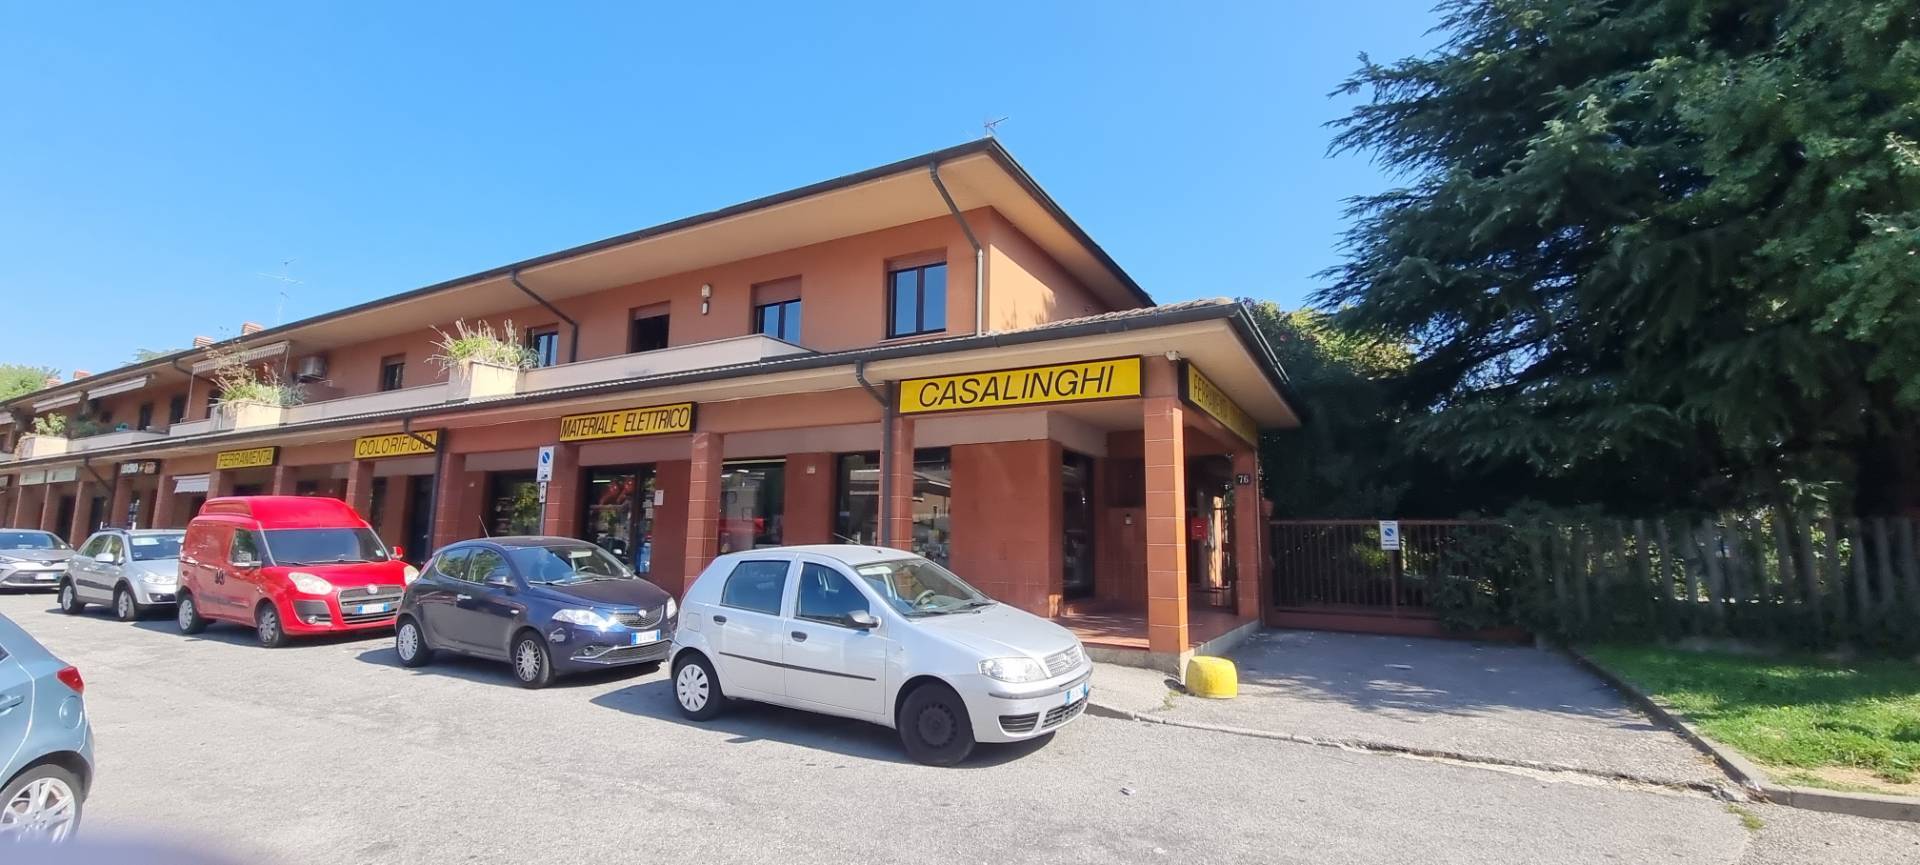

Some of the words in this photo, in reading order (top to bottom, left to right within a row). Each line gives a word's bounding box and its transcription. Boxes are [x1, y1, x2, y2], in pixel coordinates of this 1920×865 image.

[919, 365, 1115, 408] CASALINGHI
[560, 414, 620, 438] MATERIALE
[623, 407, 690, 433] ELETTRICO
[218, 449, 272, 467] FERRAMENTA
[1238, 474, 1249, 484] 76
